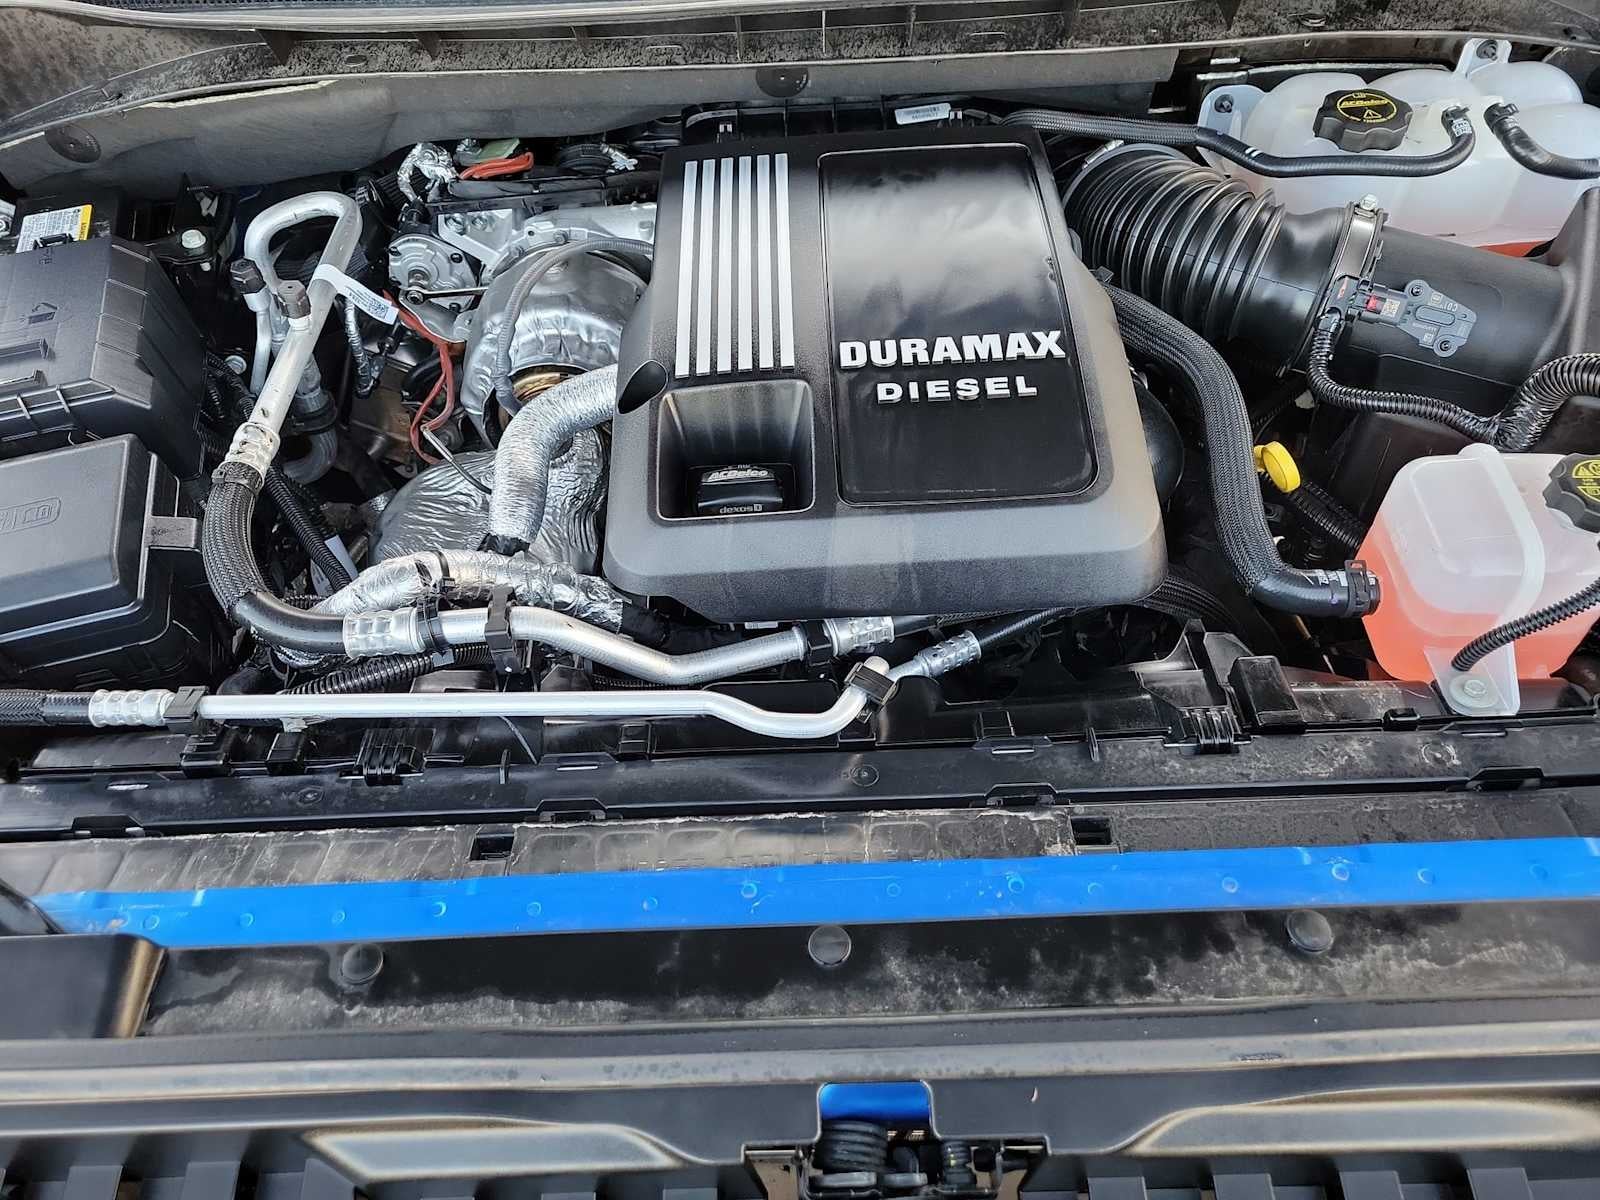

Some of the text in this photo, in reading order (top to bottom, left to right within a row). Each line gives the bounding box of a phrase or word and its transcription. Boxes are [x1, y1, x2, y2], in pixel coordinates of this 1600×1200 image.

[839, 330, 1066, 370] DURAMAX
[876, 375, 1038, 405] DIESEL
[707, 469, 769, 482] ACDelco
